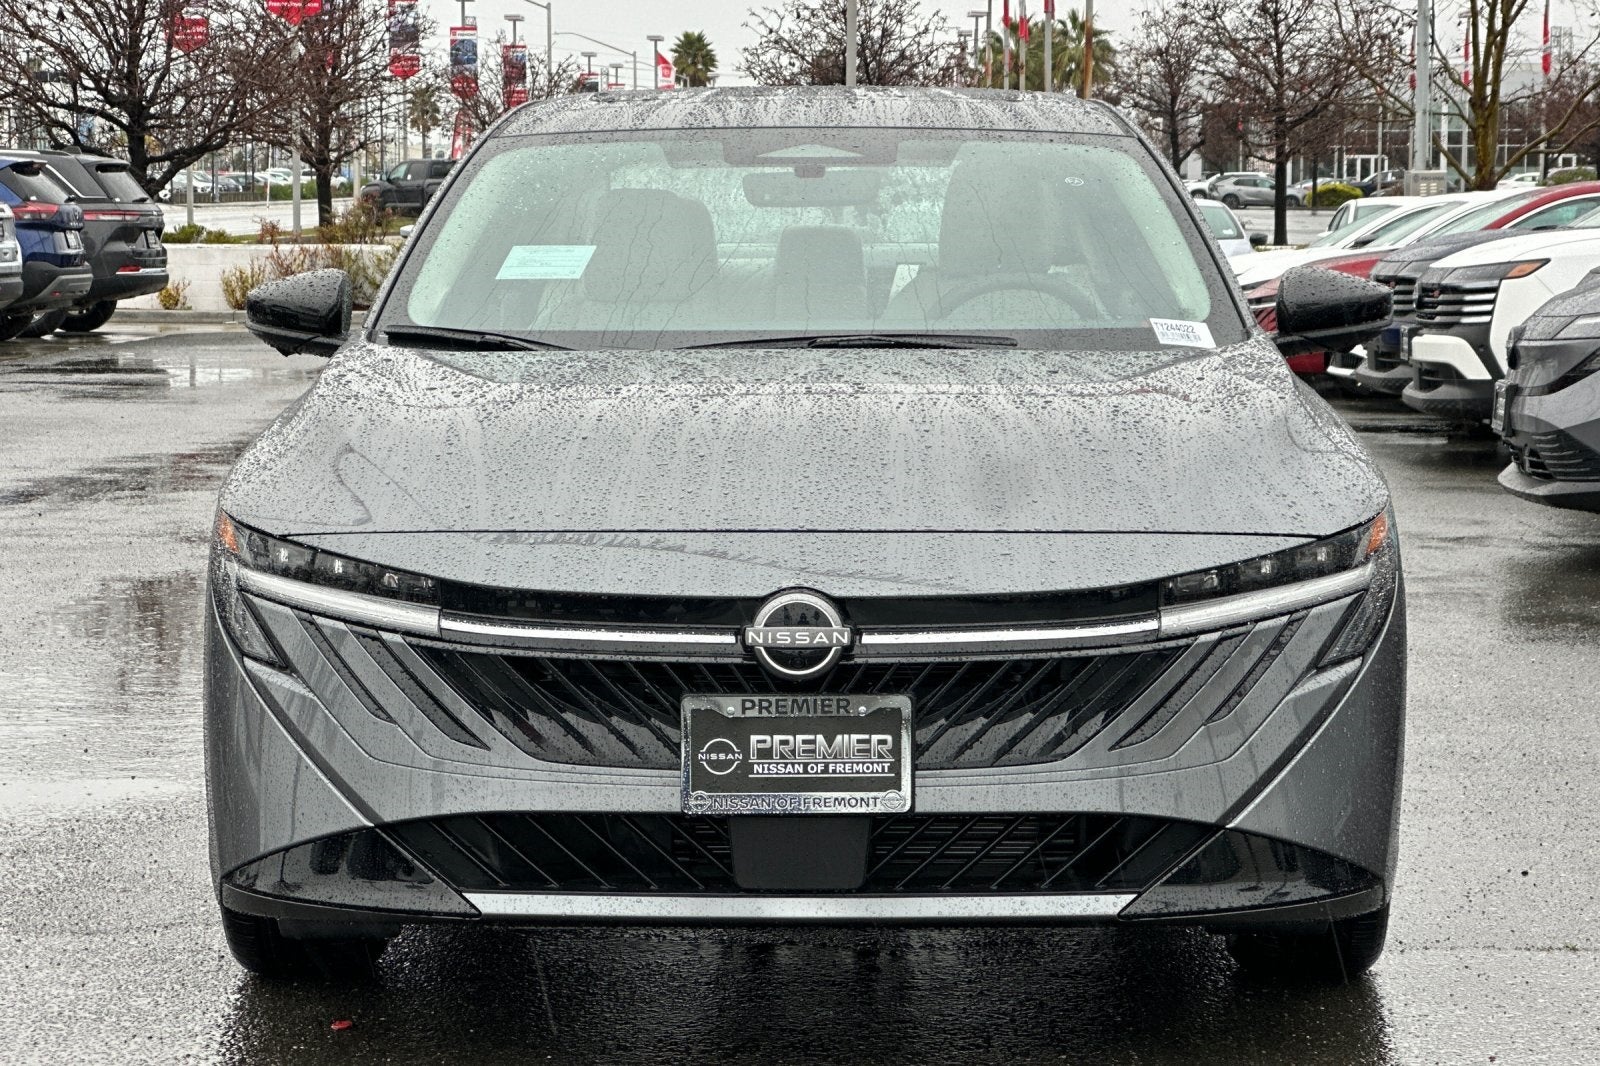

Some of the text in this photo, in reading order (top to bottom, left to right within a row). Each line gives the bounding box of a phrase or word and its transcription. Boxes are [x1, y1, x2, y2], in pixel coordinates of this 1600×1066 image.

[748, 631, 848, 644] NISSAN
[741, 699, 851, 715] PREMIER
[750, 734, 893, 759] PREMIER
[753, 762, 891, 774] NISSAN OF FREMONT
[713, 797, 778, 810] NISSAN
[781, 797, 799, 809] OF
[802, 796, 880, 808] FREMONT
